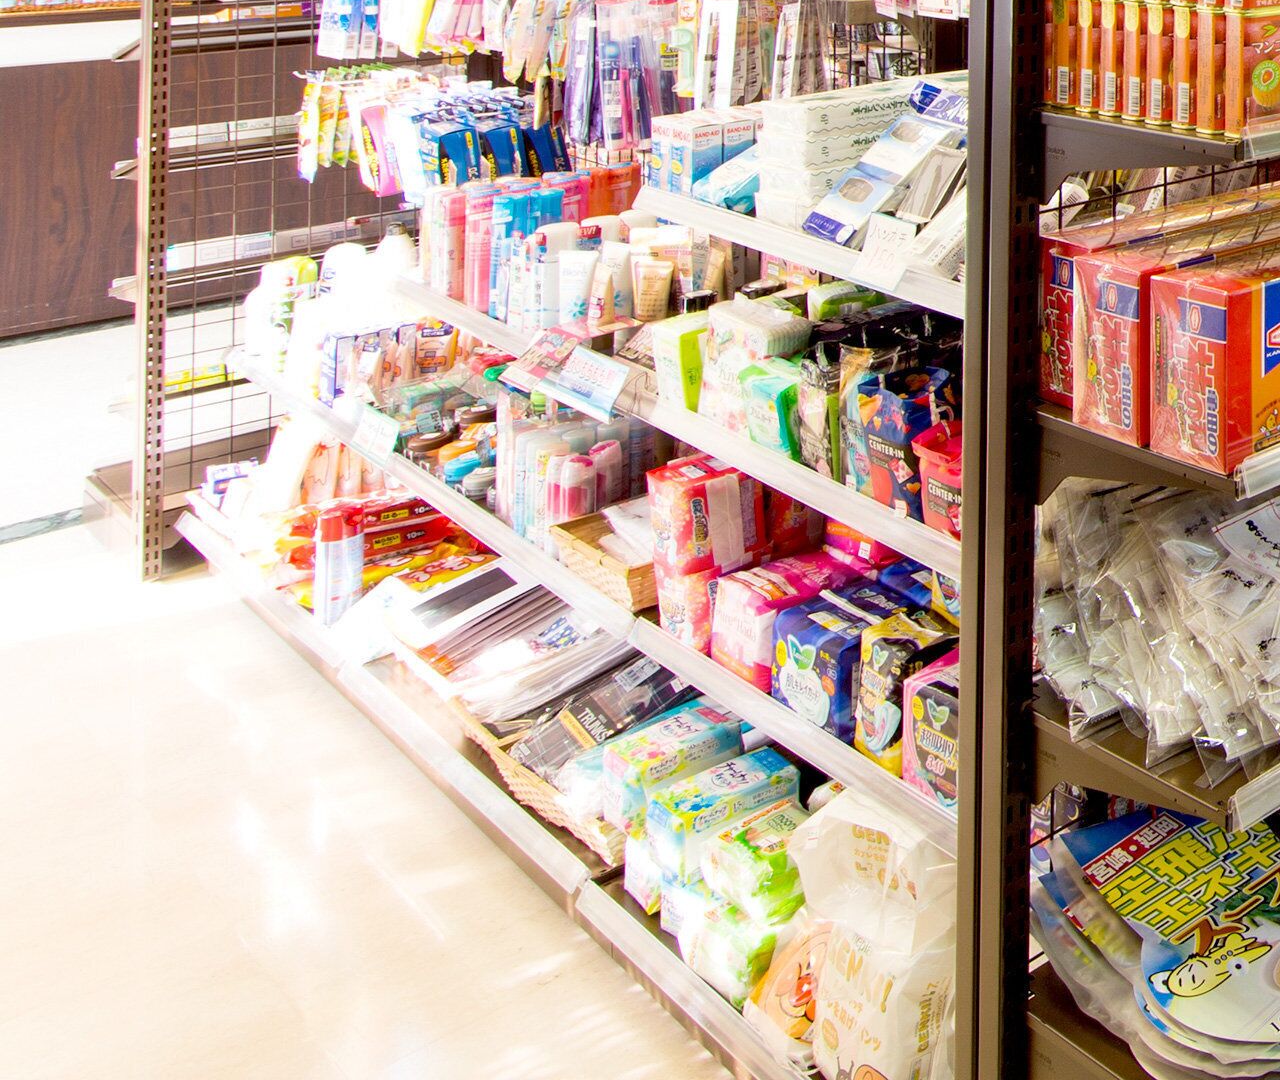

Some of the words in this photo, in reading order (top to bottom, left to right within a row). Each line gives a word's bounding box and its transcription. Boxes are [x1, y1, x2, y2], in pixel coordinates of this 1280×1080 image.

[695, 128, 720, 141] BAND-AID
[727, 124, 752, 136] BAND-AID
[868, 438, 906, 460] CENTER-IN
[577, 707, 612, 743] TRUNKS
[1084, 812, 1186, 886] 宮崎・延岡
